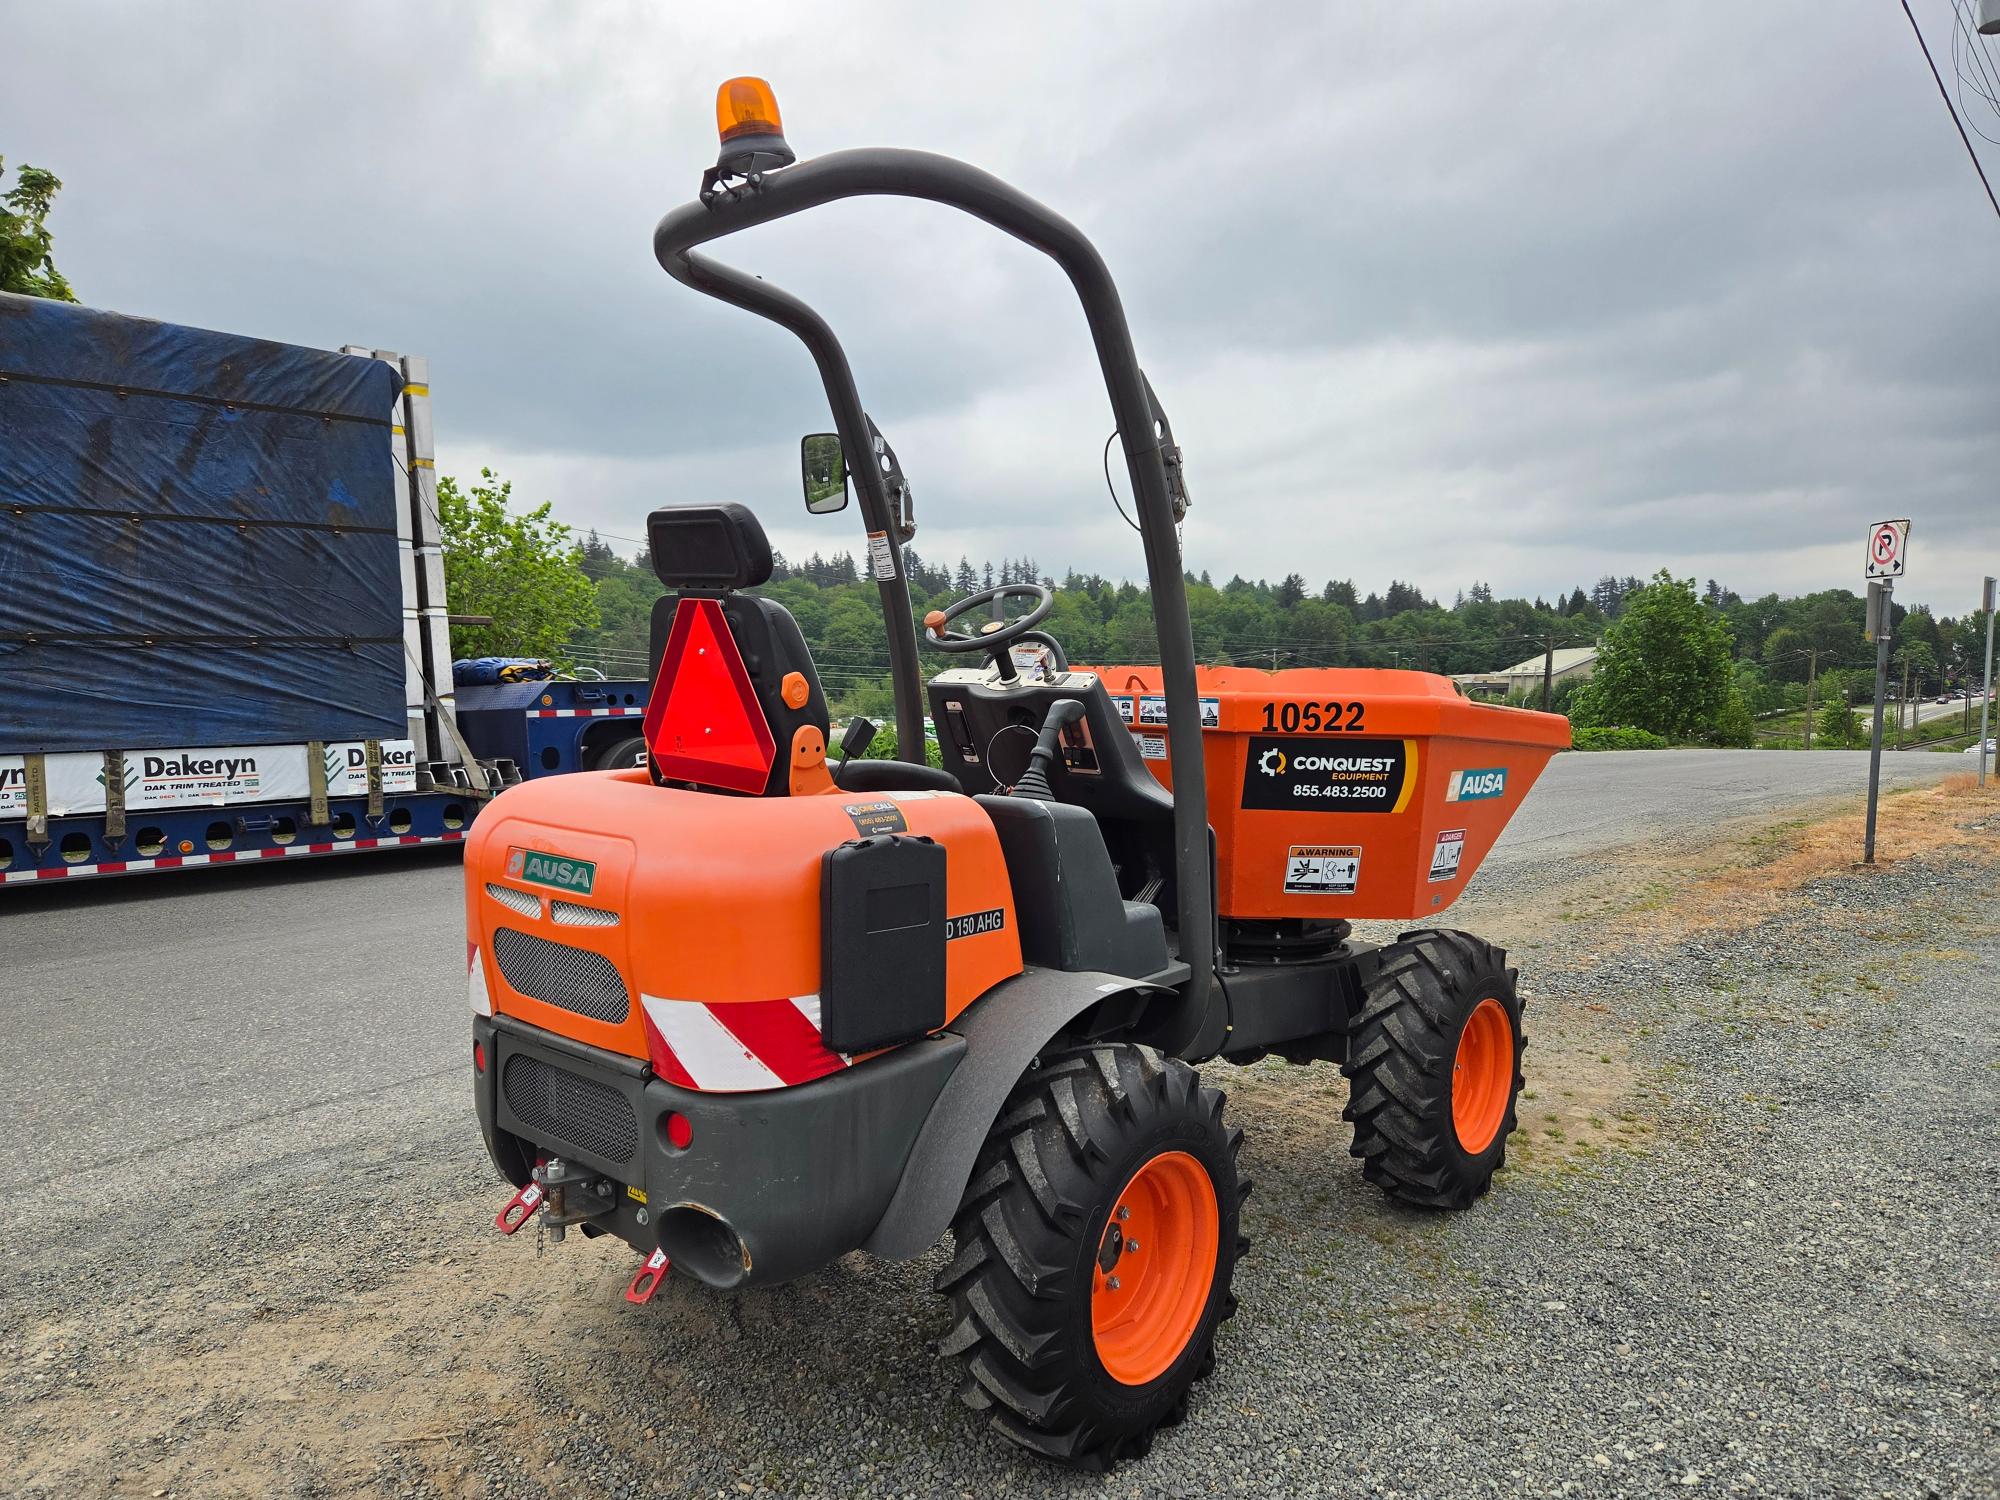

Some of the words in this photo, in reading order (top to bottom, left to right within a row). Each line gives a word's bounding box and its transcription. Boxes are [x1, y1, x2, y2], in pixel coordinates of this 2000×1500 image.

[1262, 702, 1365, 732] 10522
[143, 754, 256, 780] Dakeryn
[1293, 756, 1395, 772] CONQUEST
[197, 780, 241, 788] TREATED
[1331, 772, 1390, 781] EQUIPMENT
[1460, 773, 1503, 795] AUSA
[1292, 784, 1387, 798] 855.483.2500
[1305, 848, 1353, 856] WARNING
[525, 857, 590, 888] AUSA
[956, 917, 975, 936] 150
[976, 911, 1001, 932] AHG
